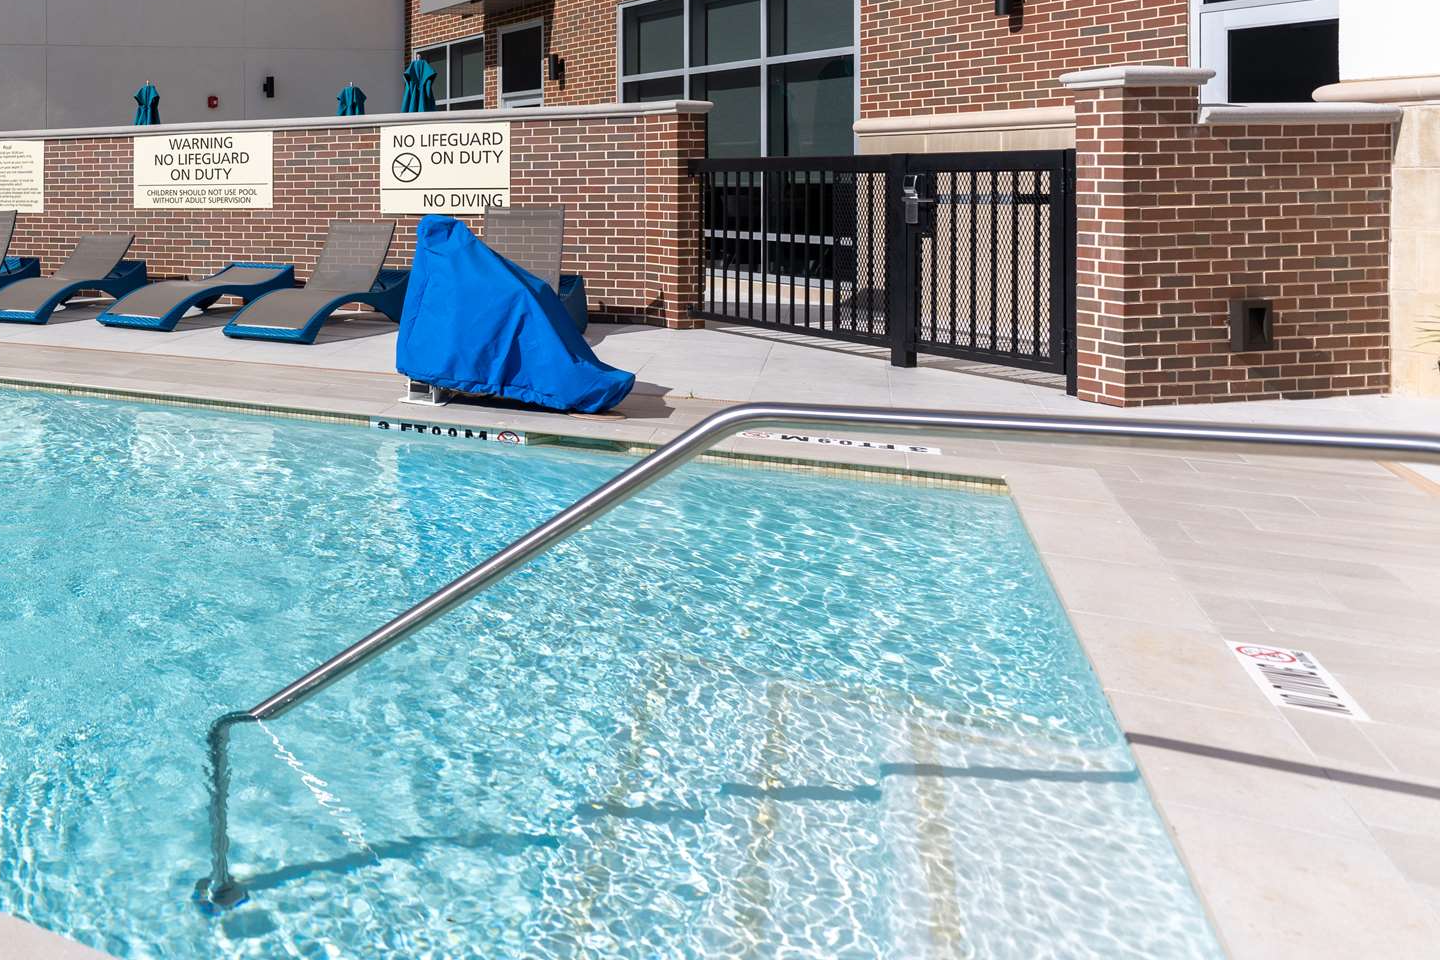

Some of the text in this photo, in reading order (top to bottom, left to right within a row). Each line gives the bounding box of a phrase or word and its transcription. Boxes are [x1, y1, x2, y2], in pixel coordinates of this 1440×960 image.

[169, 136, 233, 150] WARNING
[393, 132, 503, 148] NO LIFEGUARD
[154, 152, 250, 166] NO LIFEGUARD
[431, 150, 504, 165] ON DUTY
[170, 168, 232, 181] ON DUTY
[146, 189, 178, 197] CHILDREN
[238, 188, 257, 196] POOL
[185, 196, 207, 204] ADULT
[423, 193, 503, 208] NO DIVING
